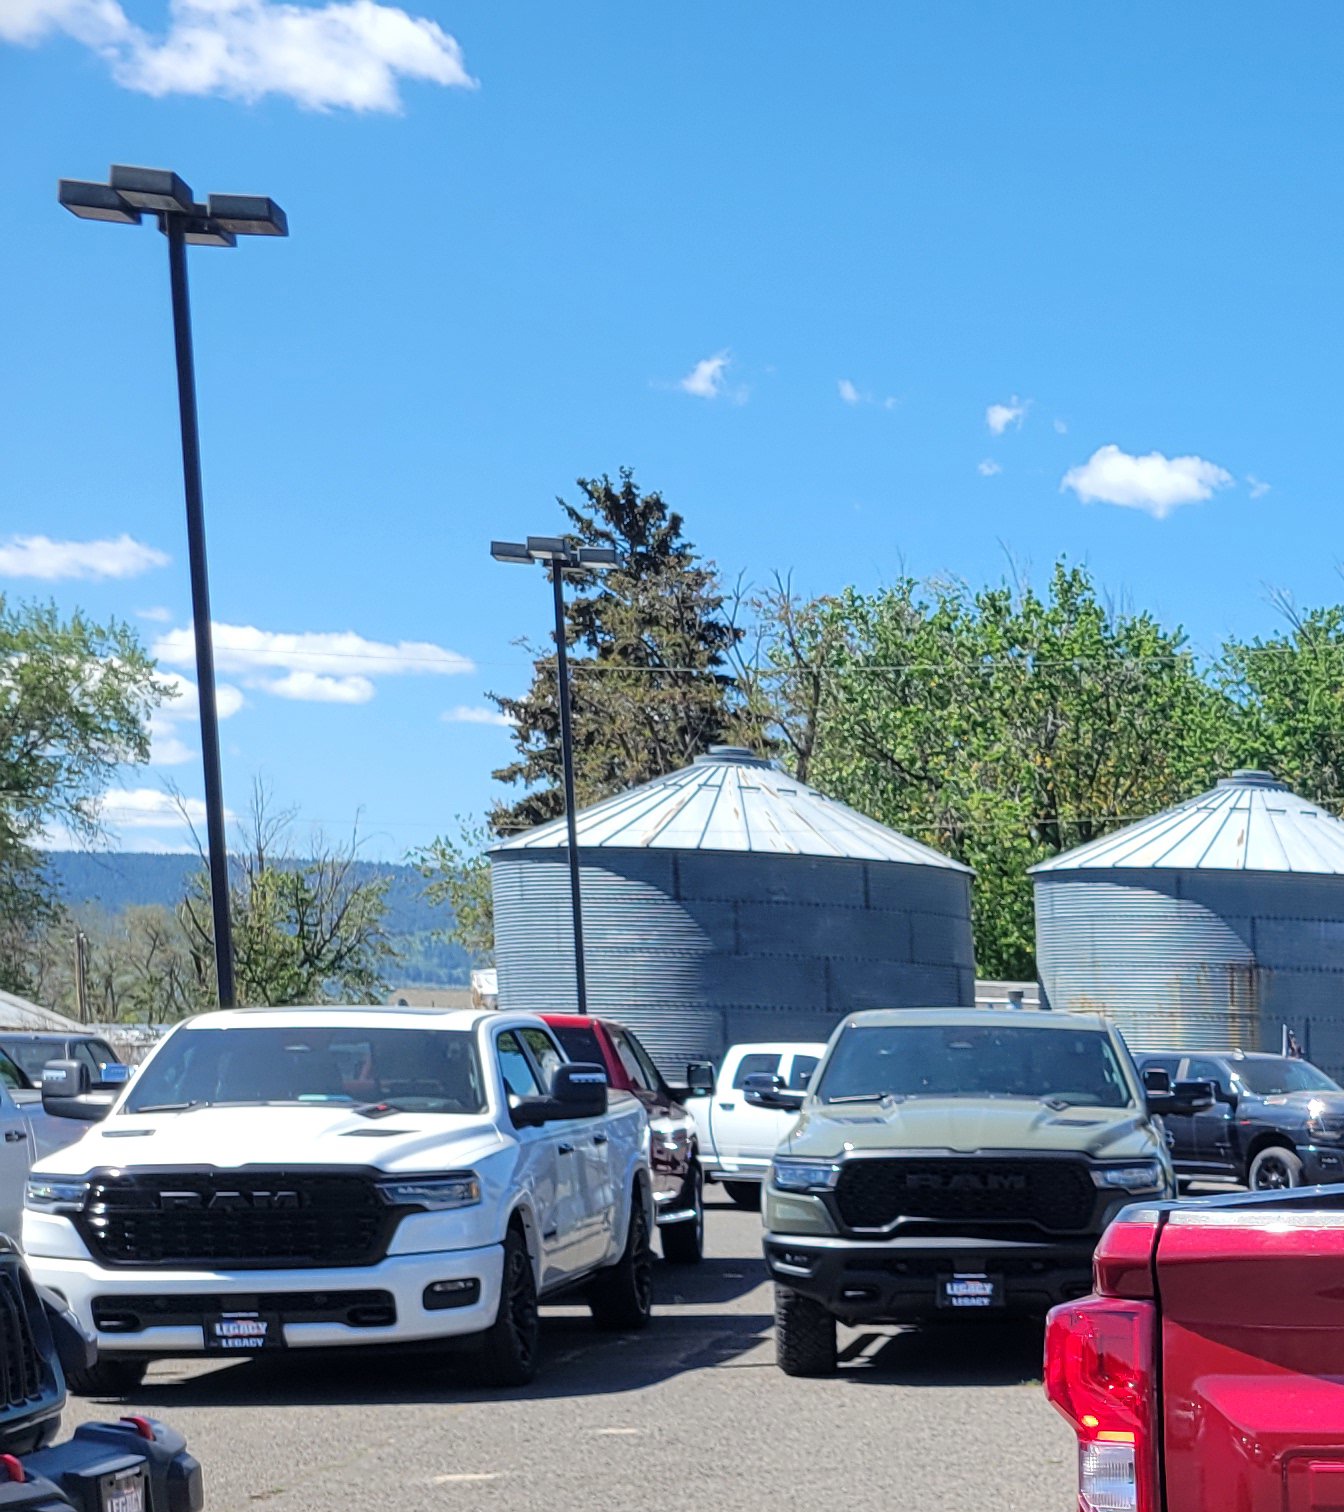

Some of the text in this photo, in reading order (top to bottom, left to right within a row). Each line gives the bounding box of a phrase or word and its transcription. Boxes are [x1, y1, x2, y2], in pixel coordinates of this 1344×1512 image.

[158, 1190, 300, 1210] RAM
[215, 1322, 267, 1337] LEGACY
[221, 1338, 264, 1348] LEGACY
